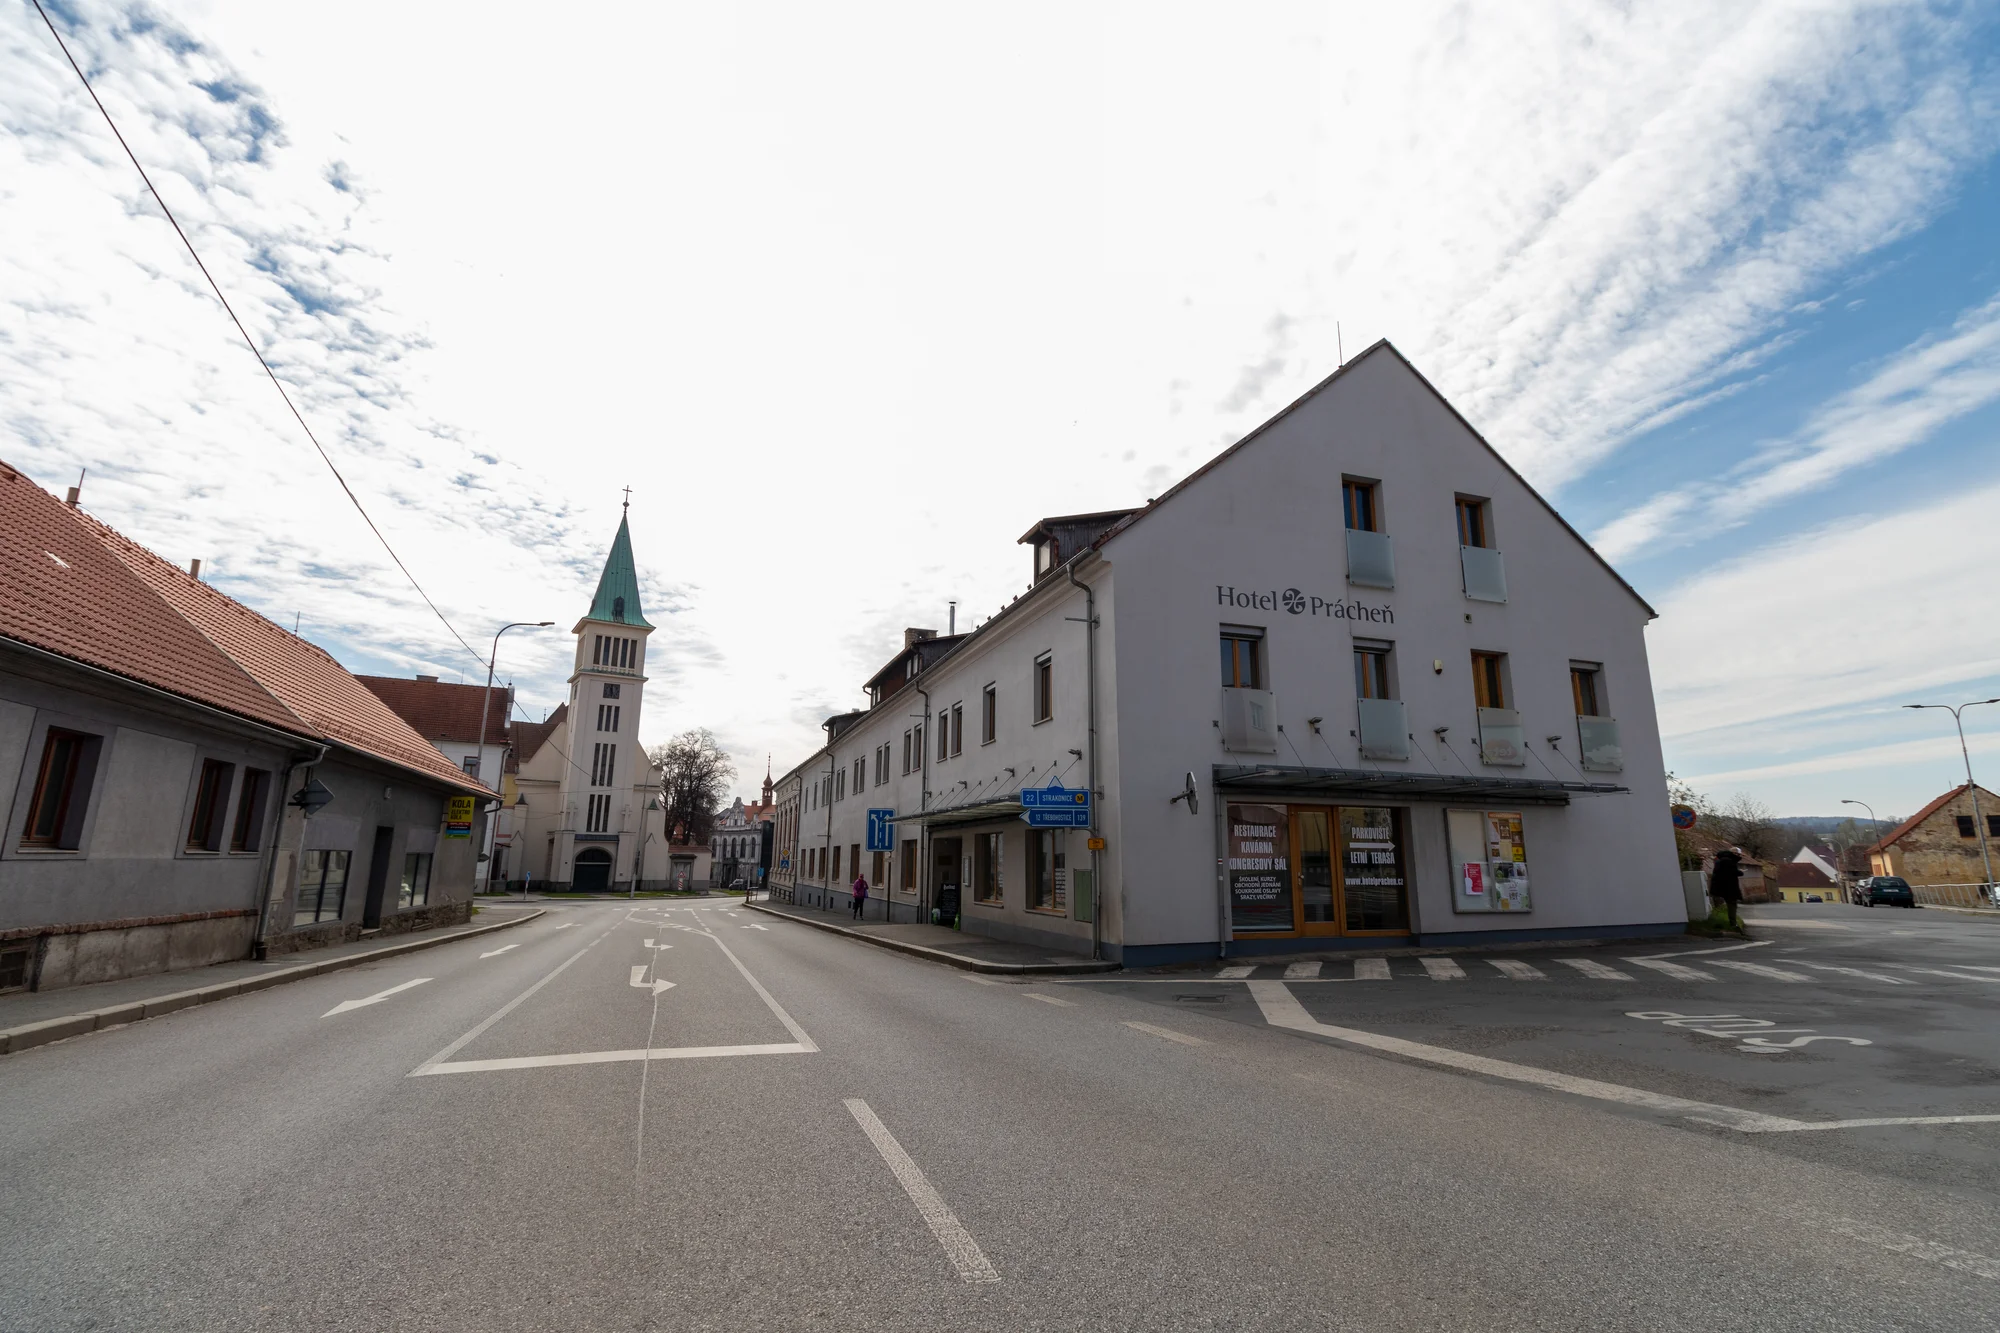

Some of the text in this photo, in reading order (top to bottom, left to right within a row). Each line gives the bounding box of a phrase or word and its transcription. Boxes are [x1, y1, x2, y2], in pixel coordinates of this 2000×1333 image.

[1216, 585, 1395, 624] Hotel Prácheň
[452, 800, 470, 808] KOLA
[1026, 794, 1035, 802] 22
[1042, 812, 1072, 821] TŘEBOHOSTICE
[1234, 825, 1276, 837] RESTAURACE
[1352, 826, 1389, 839] PARKOVIŠTĚ
[1241, 840, 1273, 853] KAVÁRNA
[1274, 856, 1287, 870] SÁL
[1351, 850, 1395, 864] LETNÍ TERASA
[1345, 877, 1403, 886] www.hotelprachen.cz
